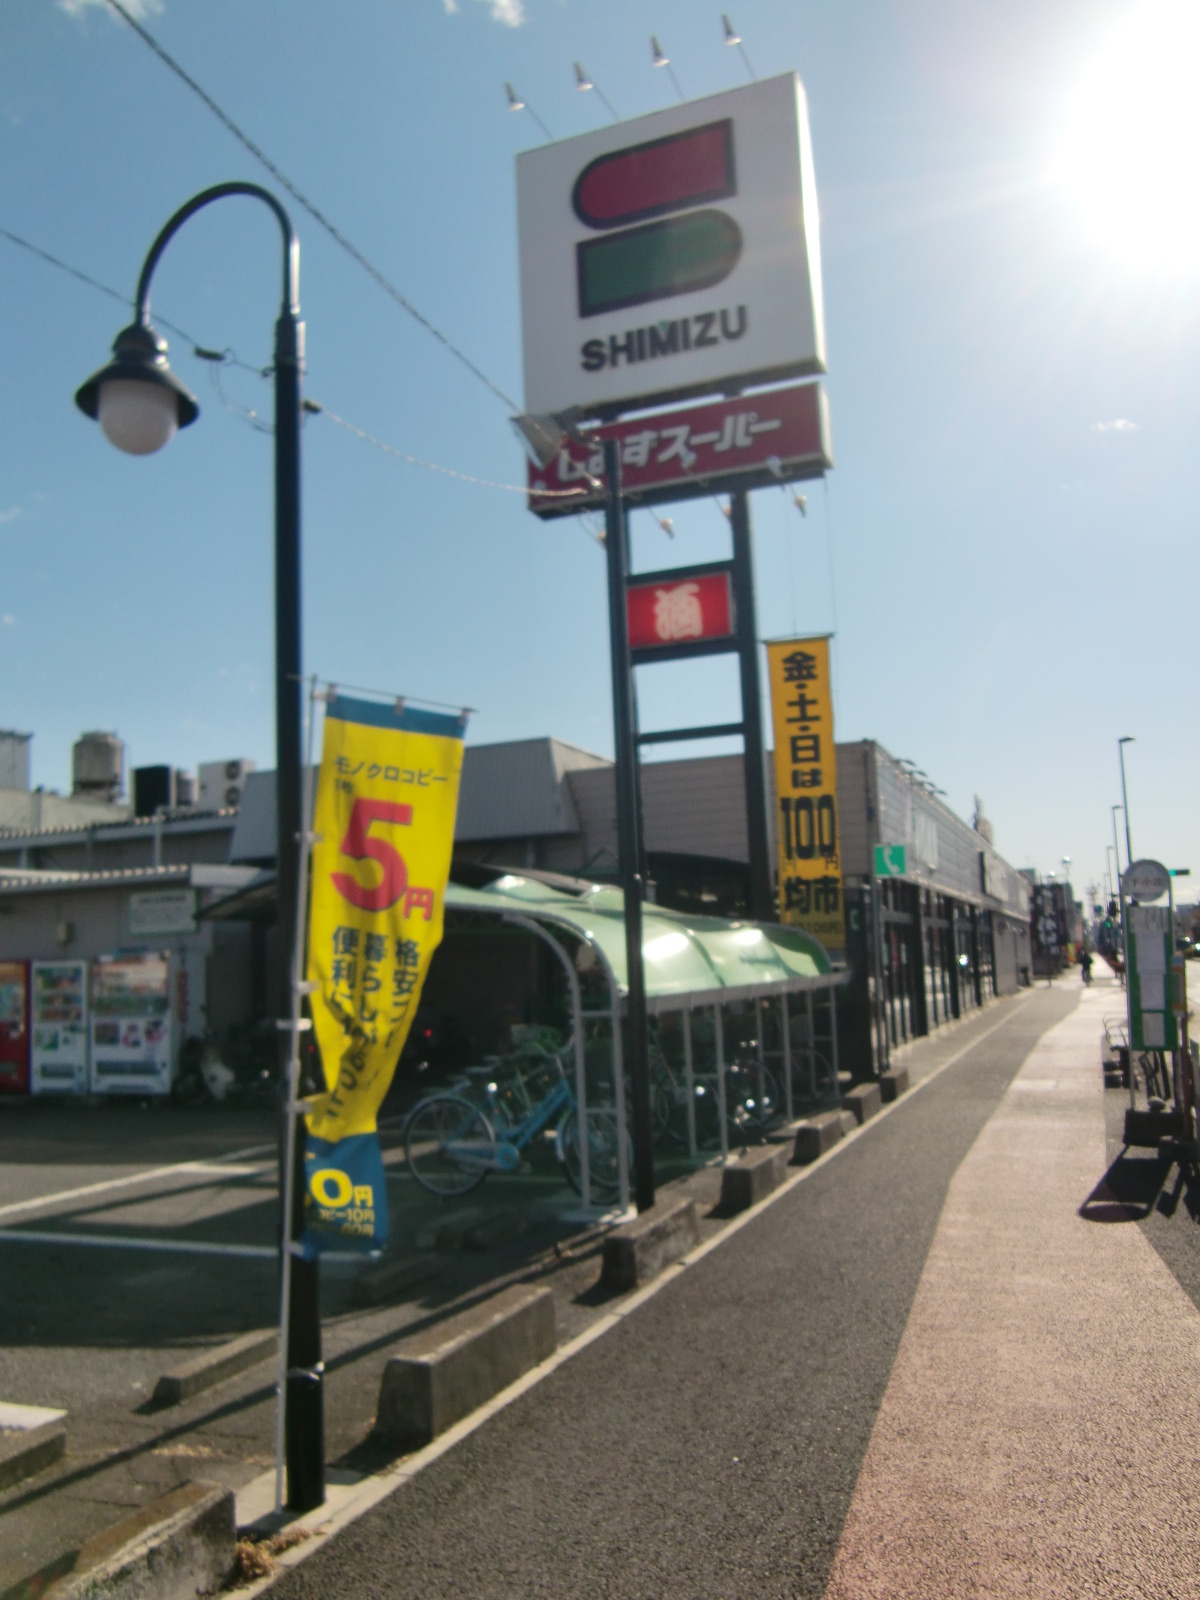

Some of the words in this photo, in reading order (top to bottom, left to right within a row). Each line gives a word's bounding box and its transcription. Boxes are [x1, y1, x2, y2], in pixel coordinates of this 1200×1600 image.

[580, 304, 748, 372] SHIMIZU
[335, 755, 448, 787] モノクロコピー
[331, 796, 434, 921] 5円
